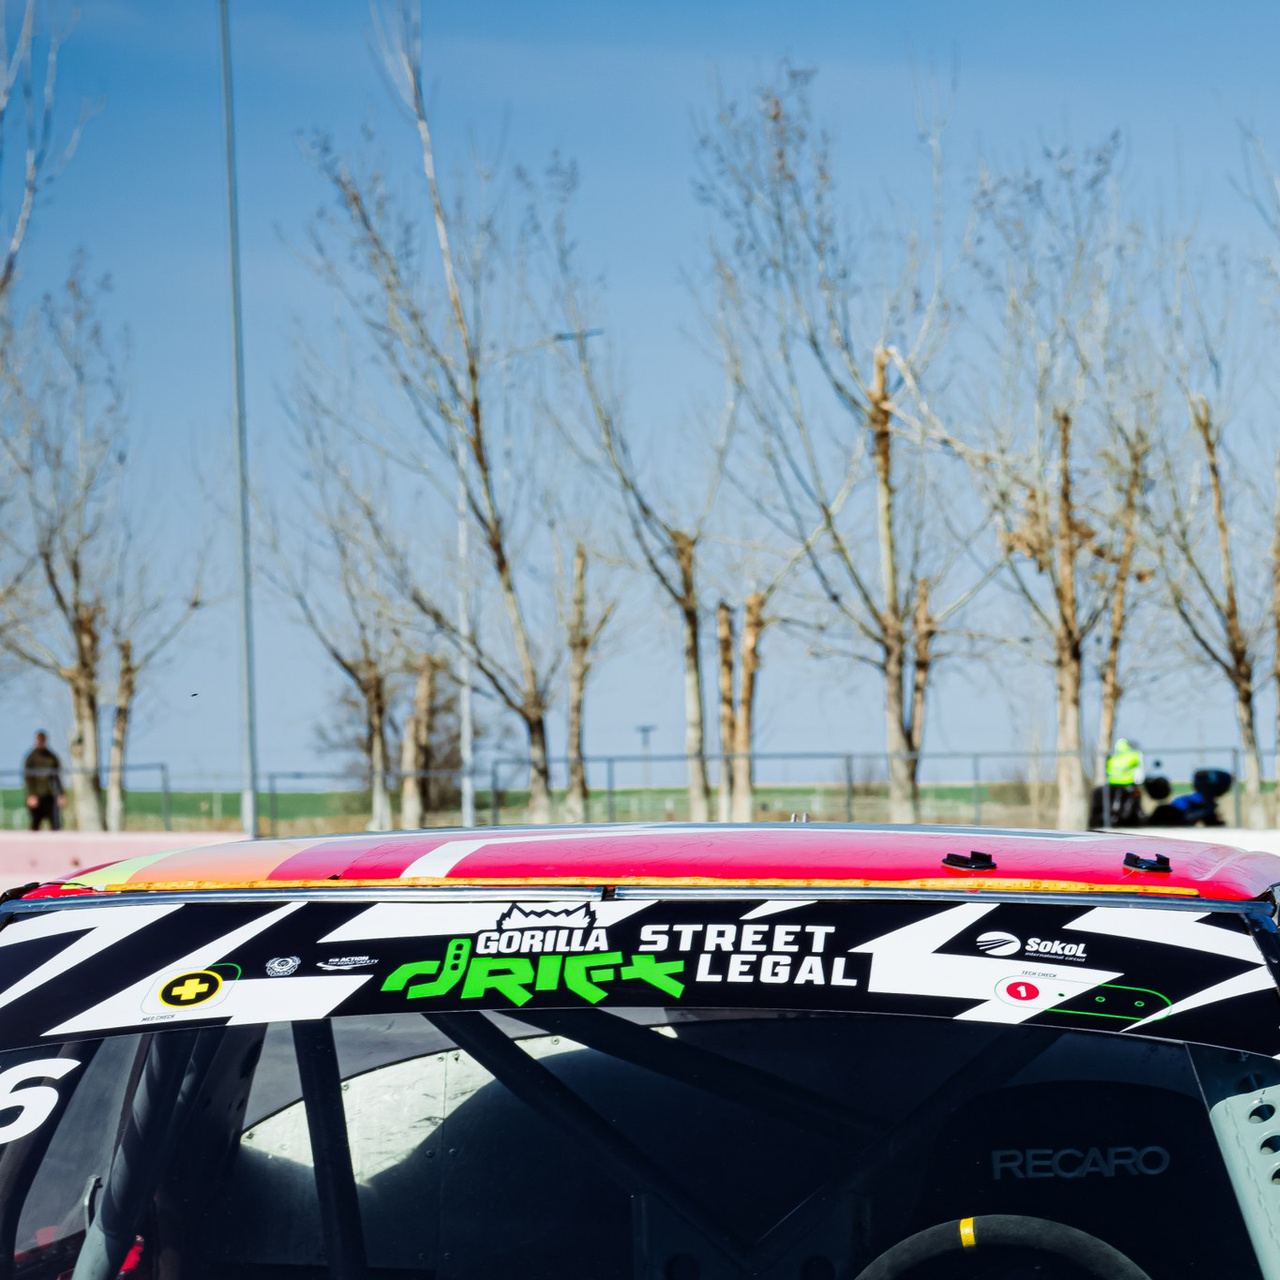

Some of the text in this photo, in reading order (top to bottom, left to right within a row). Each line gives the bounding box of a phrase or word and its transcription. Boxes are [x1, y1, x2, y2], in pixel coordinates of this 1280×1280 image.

[475, 928, 609, 954] GORILLA
[638, 924, 836, 953] STREET
[339, 955, 369, 963] ACTION
[695, 954, 858, 987] LEGAL
[1016, 985, 1027, 998] 1
[991, 1145, 1171, 1180] RECARO
